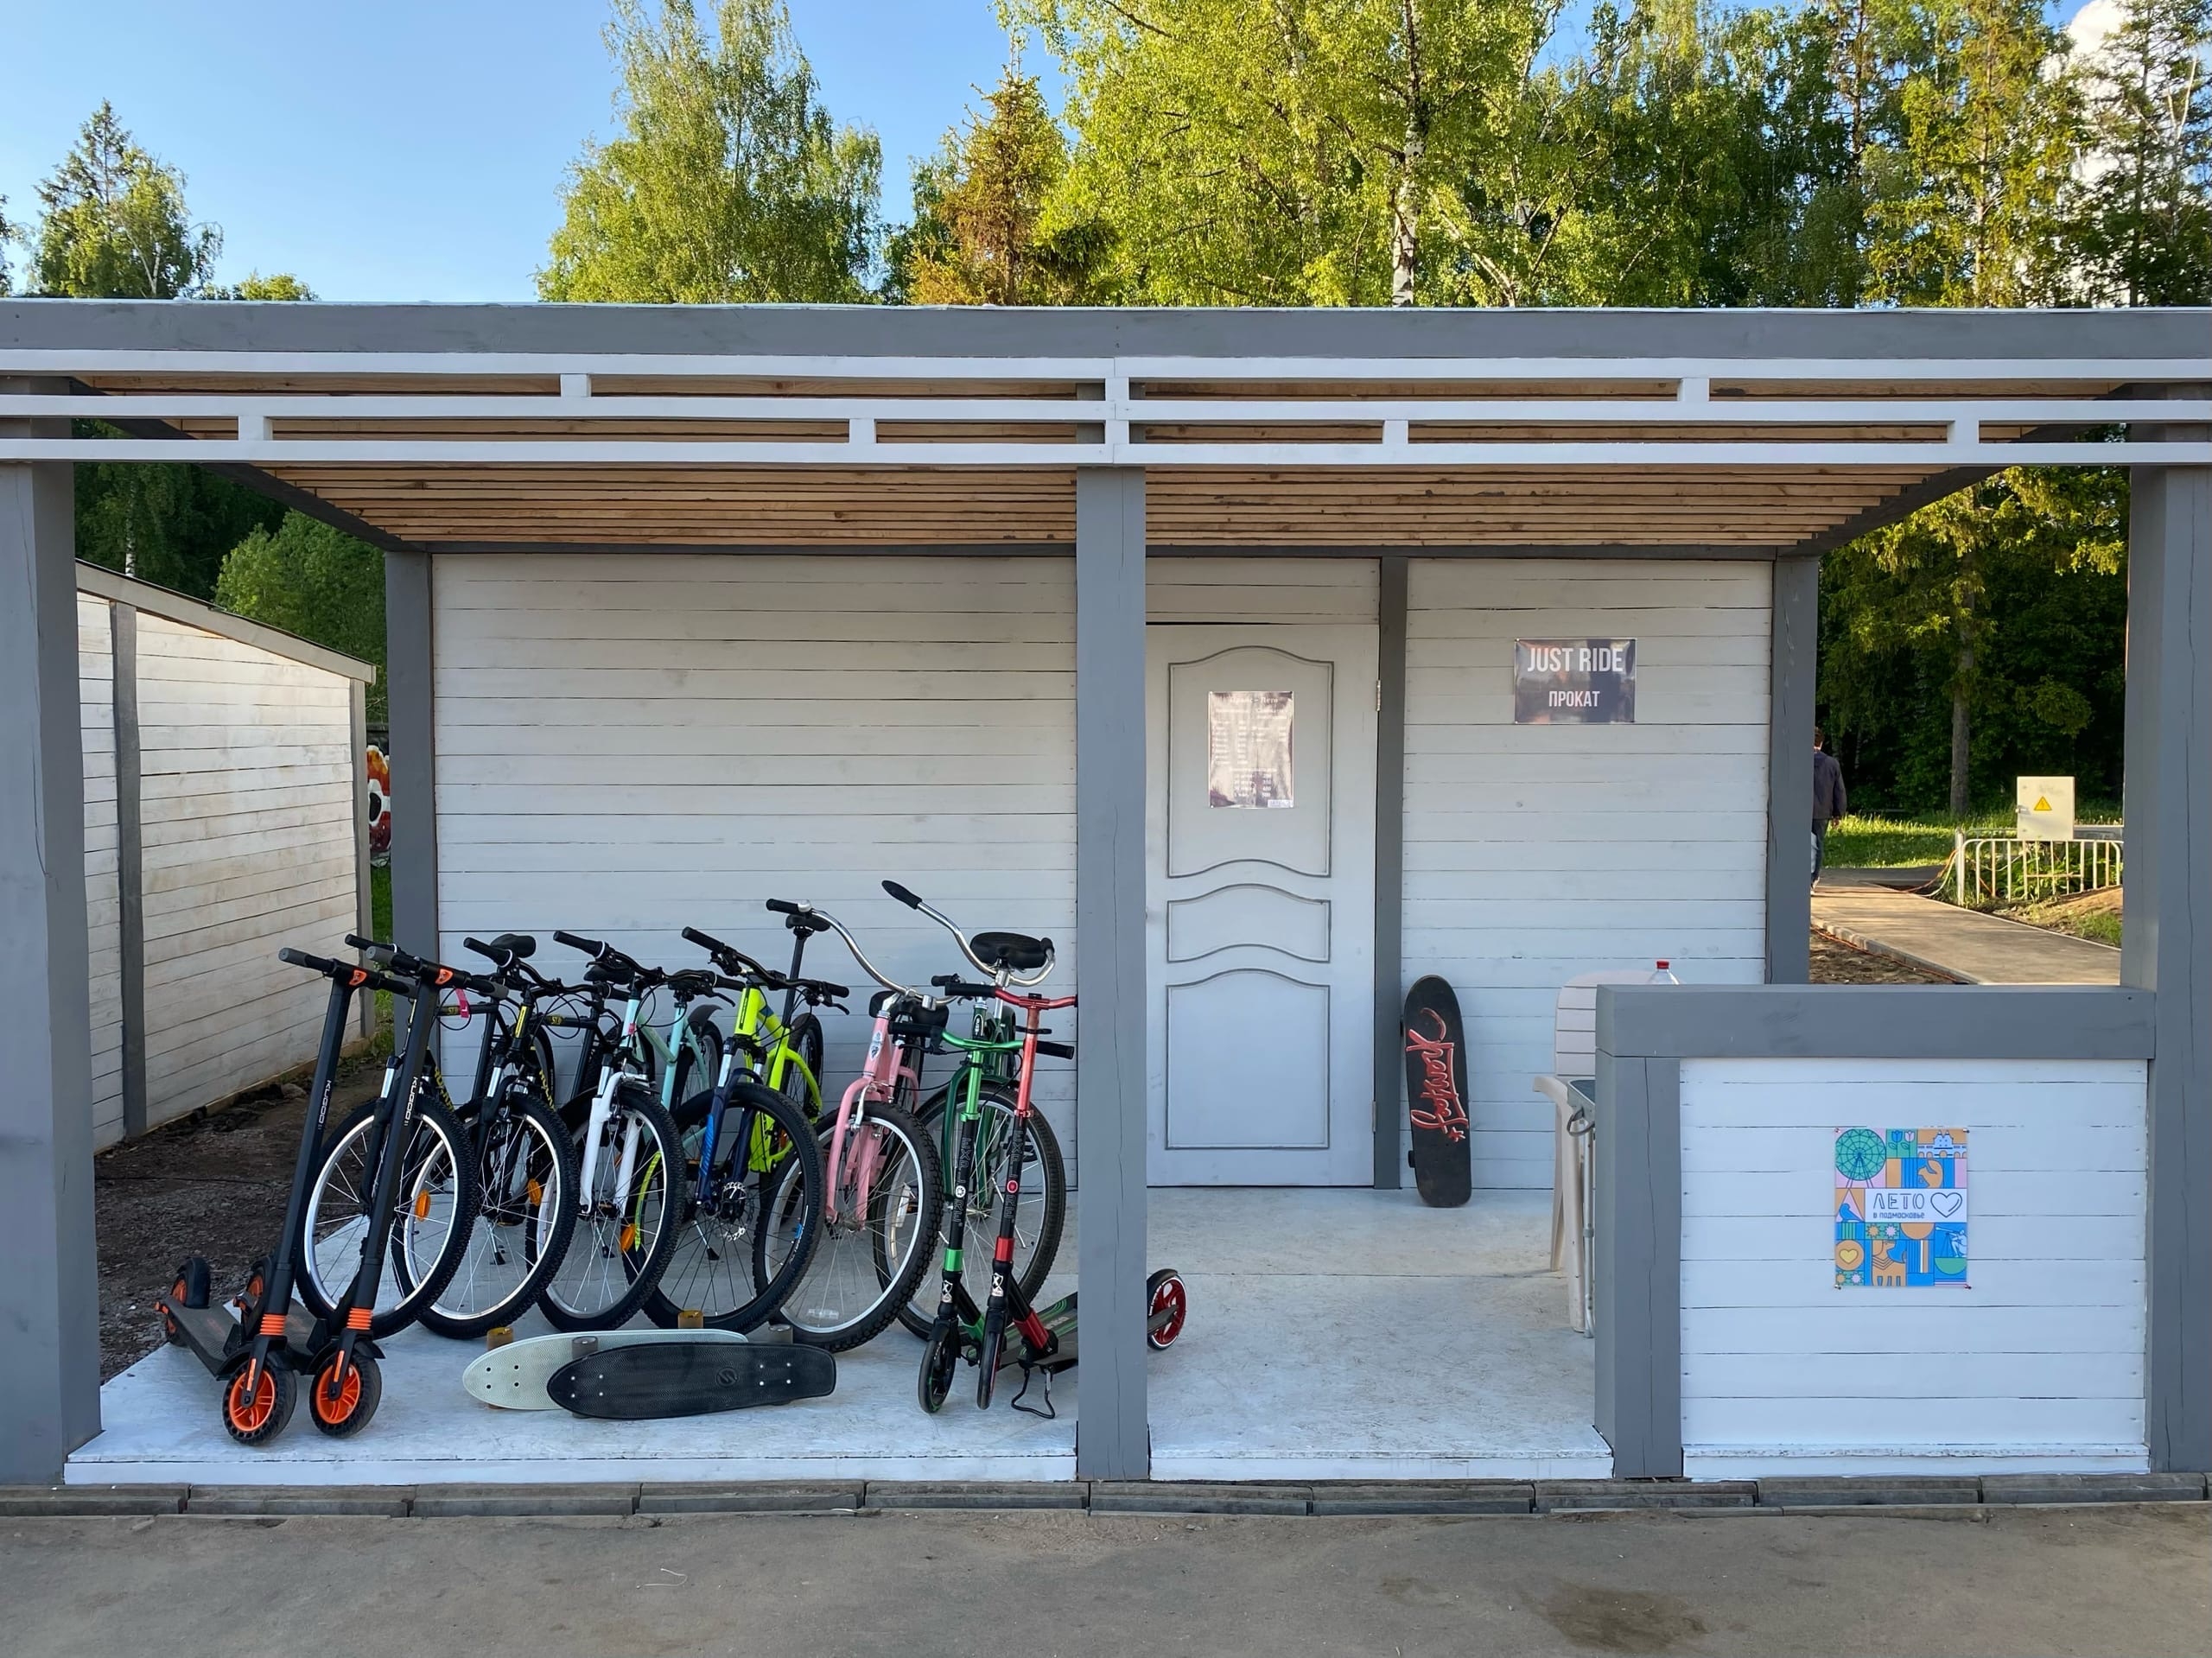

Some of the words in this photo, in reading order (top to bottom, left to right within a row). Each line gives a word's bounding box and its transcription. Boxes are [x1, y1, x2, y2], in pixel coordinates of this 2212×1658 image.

[1527, 647, 1573, 672] JUST
[1579, 647, 1624, 672] RIDE
[1548, 690, 1600, 707] ПРОКАТ
[318, 1079, 332, 1124] KUGOO
[404, 1077, 418, 1121] KUGOO
[1873, 1193, 1925, 1210] ЛЕТО
